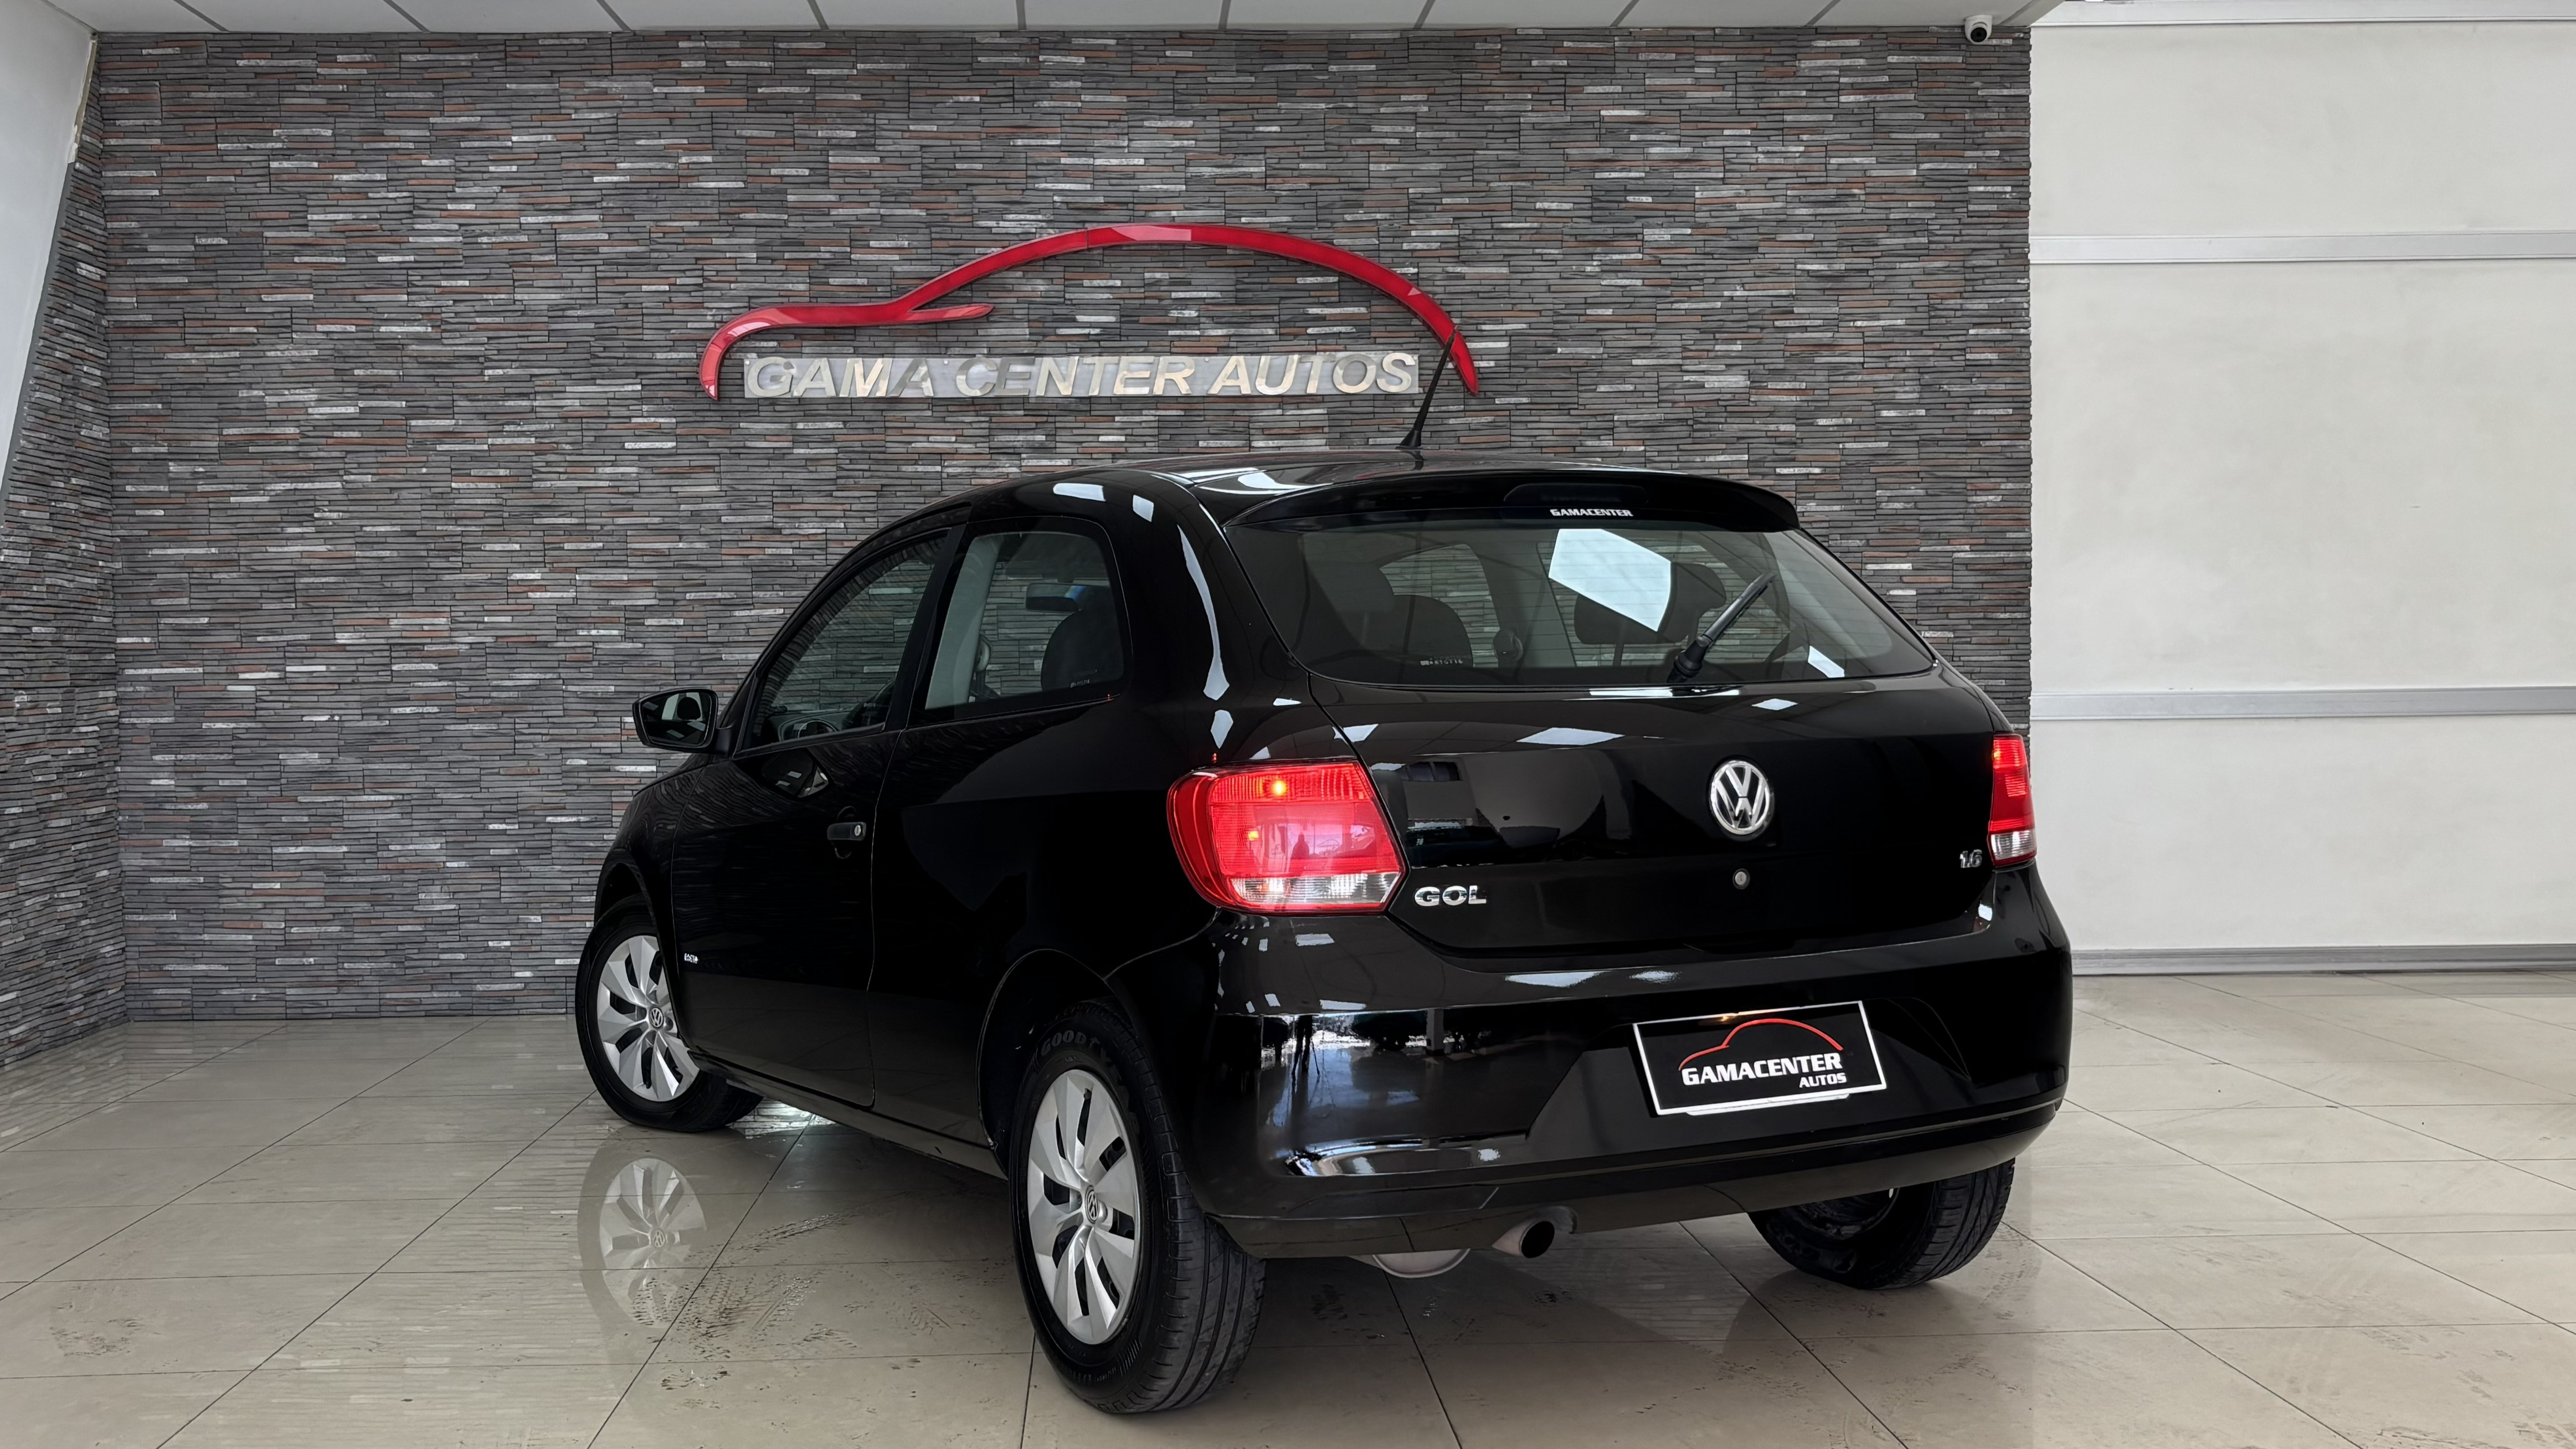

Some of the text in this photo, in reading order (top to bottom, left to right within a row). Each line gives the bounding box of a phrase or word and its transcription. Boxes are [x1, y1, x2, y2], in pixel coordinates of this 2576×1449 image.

[747, 352, 1416, 398] GAMA CENTER AUTOS
[1550, 508, 1634, 517] GAMACENTER
[1414, 885, 1487, 907] GOL
[1681, 1052, 1843, 1086] GAMACENTER
[1798, 1072, 1847, 1088] AUTOS
